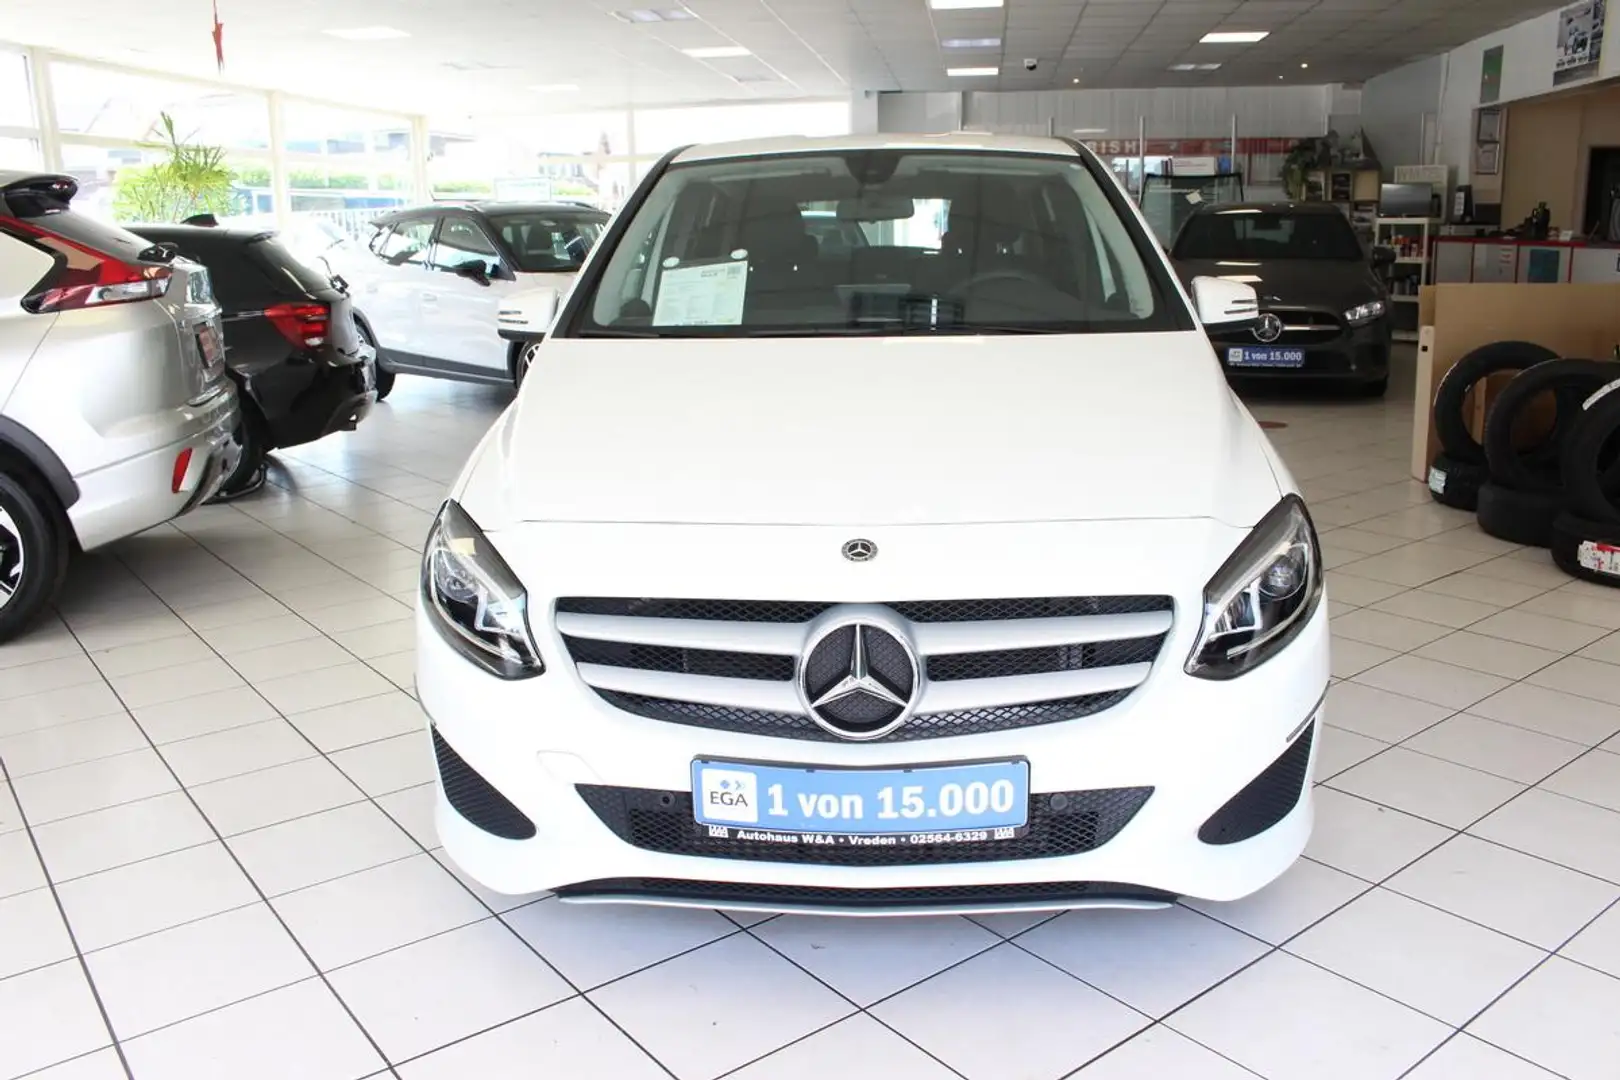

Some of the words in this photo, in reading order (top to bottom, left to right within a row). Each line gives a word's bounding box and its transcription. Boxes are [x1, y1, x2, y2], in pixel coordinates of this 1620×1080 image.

[1244, 351, 1250, 360] 1
[710, 791, 748, 807] EGA
[768, 783, 789, 817] 1
[797, 793, 863, 819] von
[877, 779, 1014, 819] 15.000
[736, 830, 798, 843] Autohaus
[801, 834, 835, 845] W&A
[848, 835, 897, 845] Vreden
